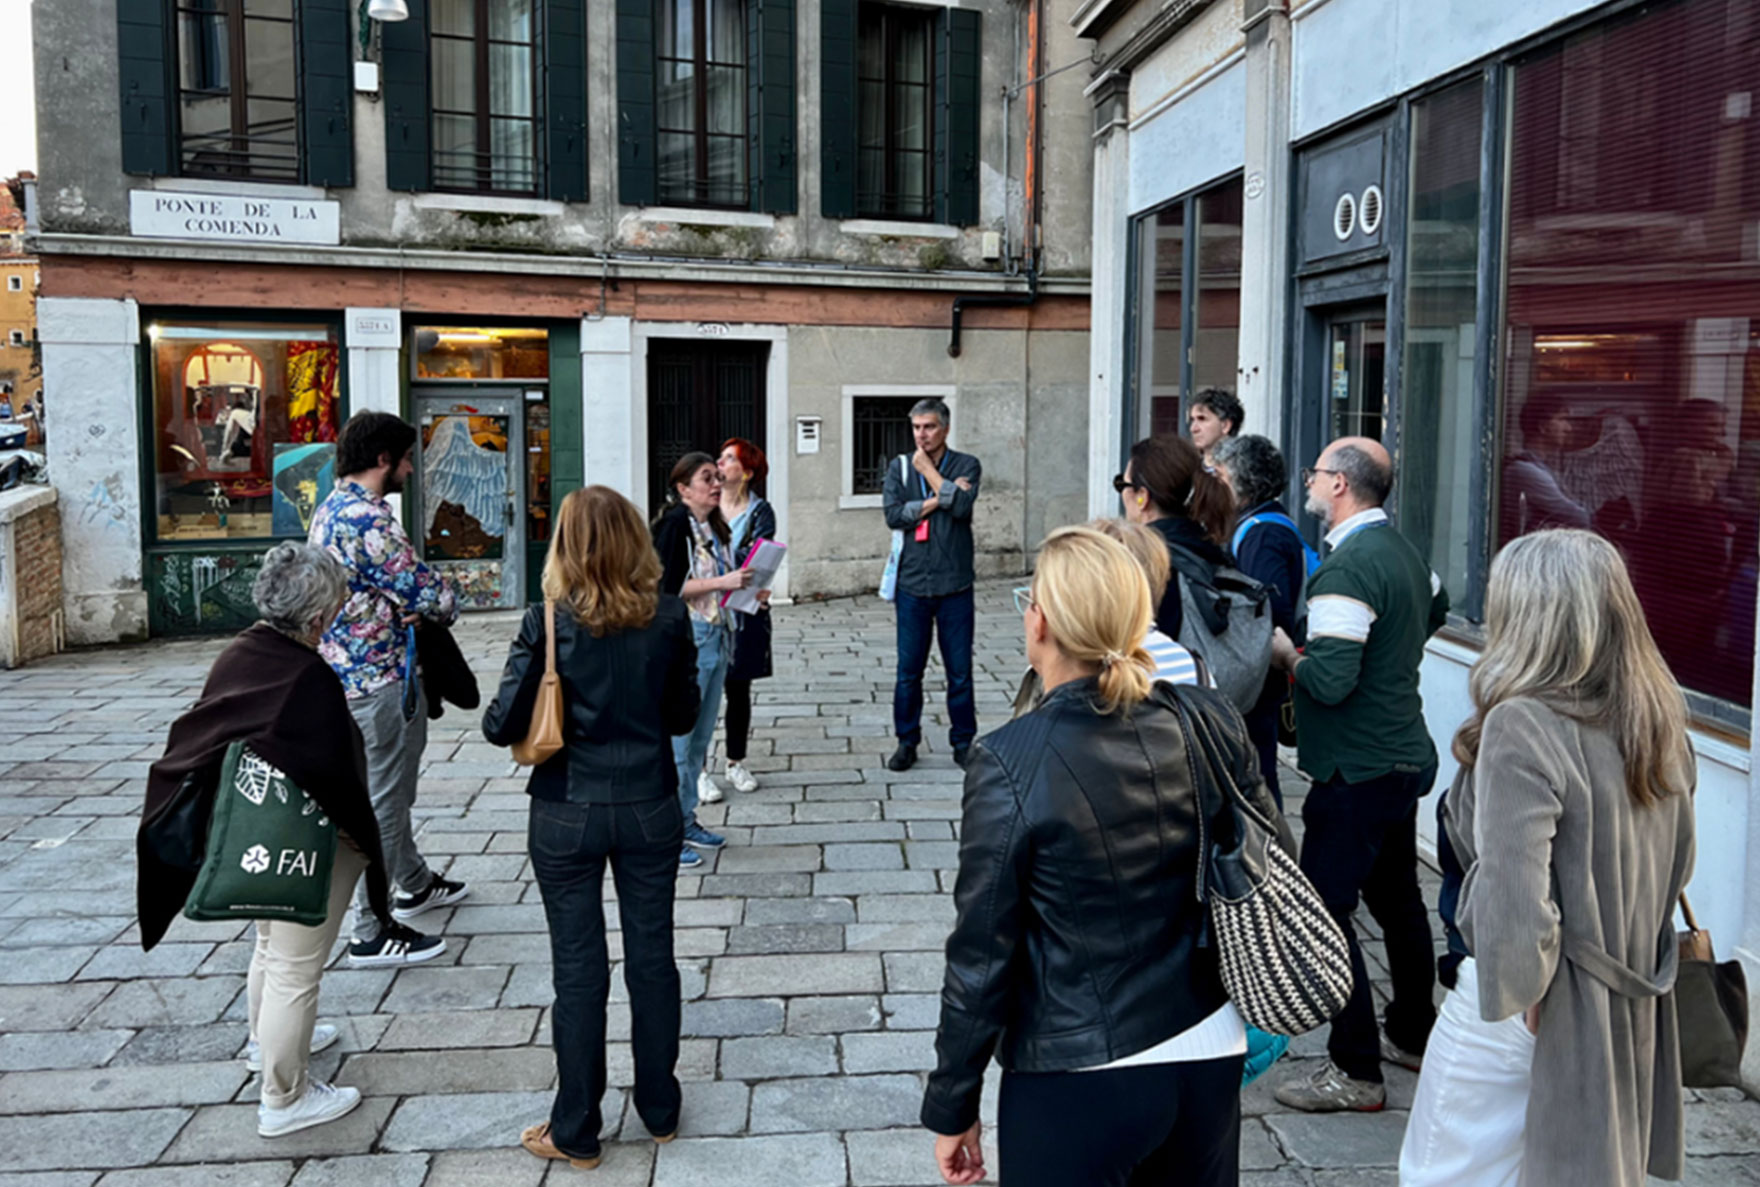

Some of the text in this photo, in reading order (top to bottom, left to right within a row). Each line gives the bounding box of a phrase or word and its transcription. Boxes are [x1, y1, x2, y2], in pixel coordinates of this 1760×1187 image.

[155, 198, 317, 220] PONTE DE LA
[184, 218, 281, 236] COMENDA
[276, 848, 317, 876] FAI
